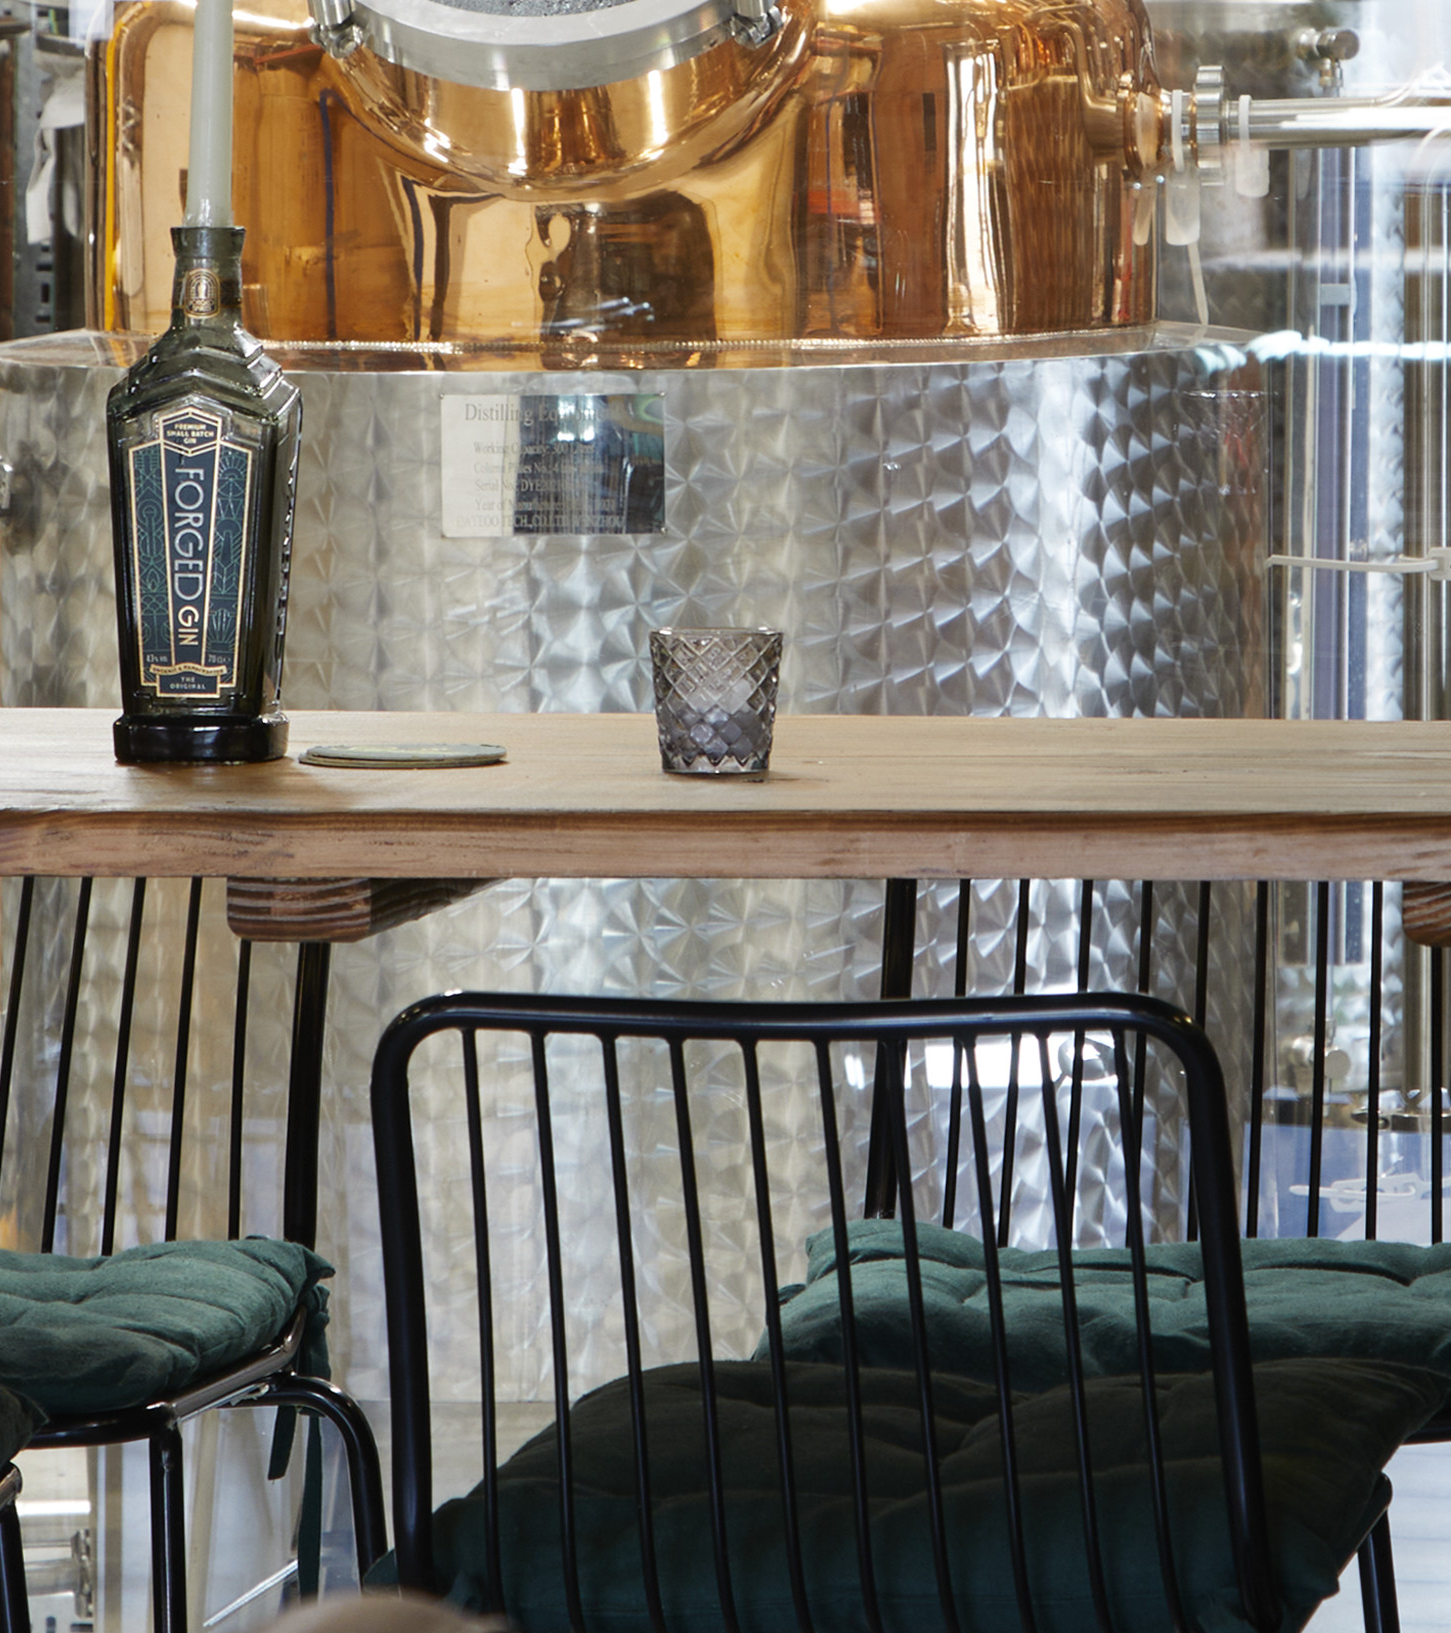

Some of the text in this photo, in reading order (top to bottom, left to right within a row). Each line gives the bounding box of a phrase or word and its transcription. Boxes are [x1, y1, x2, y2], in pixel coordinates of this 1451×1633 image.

[465, 403, 533, 426] Distilling
[174, 468, 204, 646] FORGED GIN
